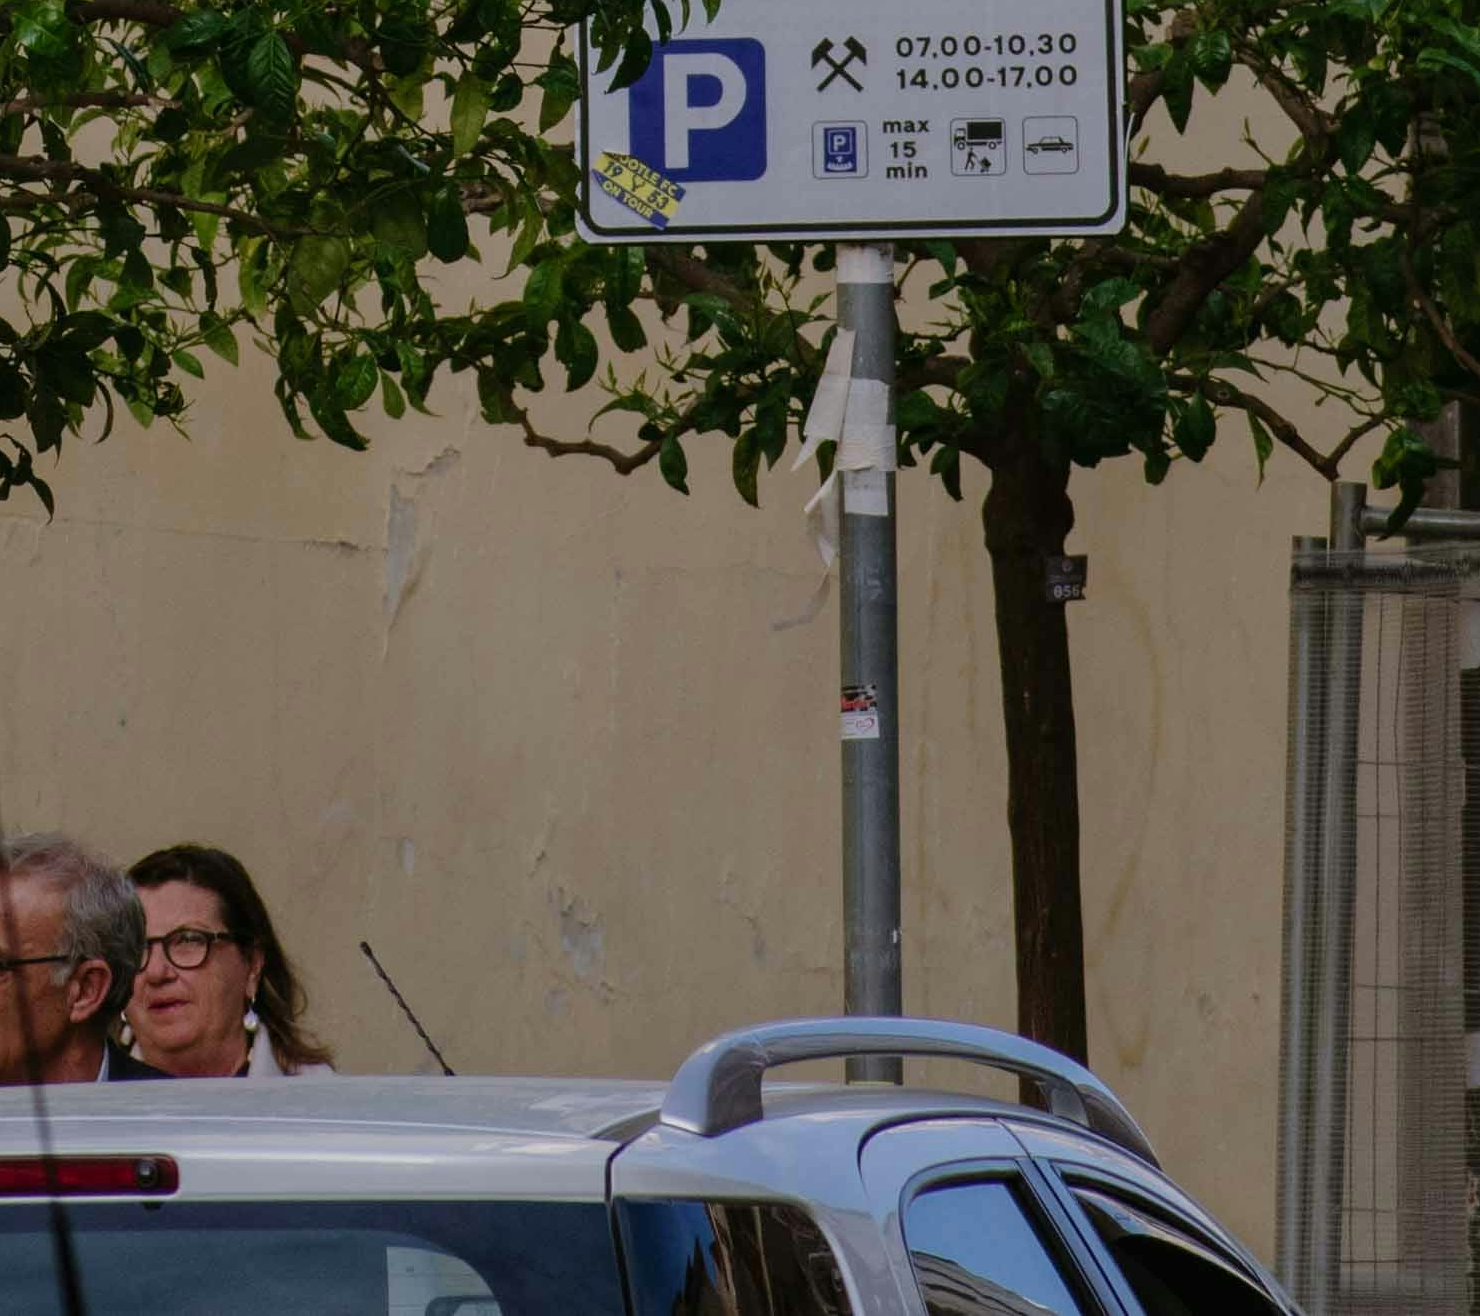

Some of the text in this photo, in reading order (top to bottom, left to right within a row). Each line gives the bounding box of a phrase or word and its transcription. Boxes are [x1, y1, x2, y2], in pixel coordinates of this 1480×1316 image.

[663, 52, 747, 170] P
[882, 119, 930, 134] max
[833, 134, 846, 152] P
[890, 141, 917, 159] 15
[618, 154, 661, 184] OOTLE
[886, 161, 928, 179] min
[603, 181, 653, 218] ON TOUR
